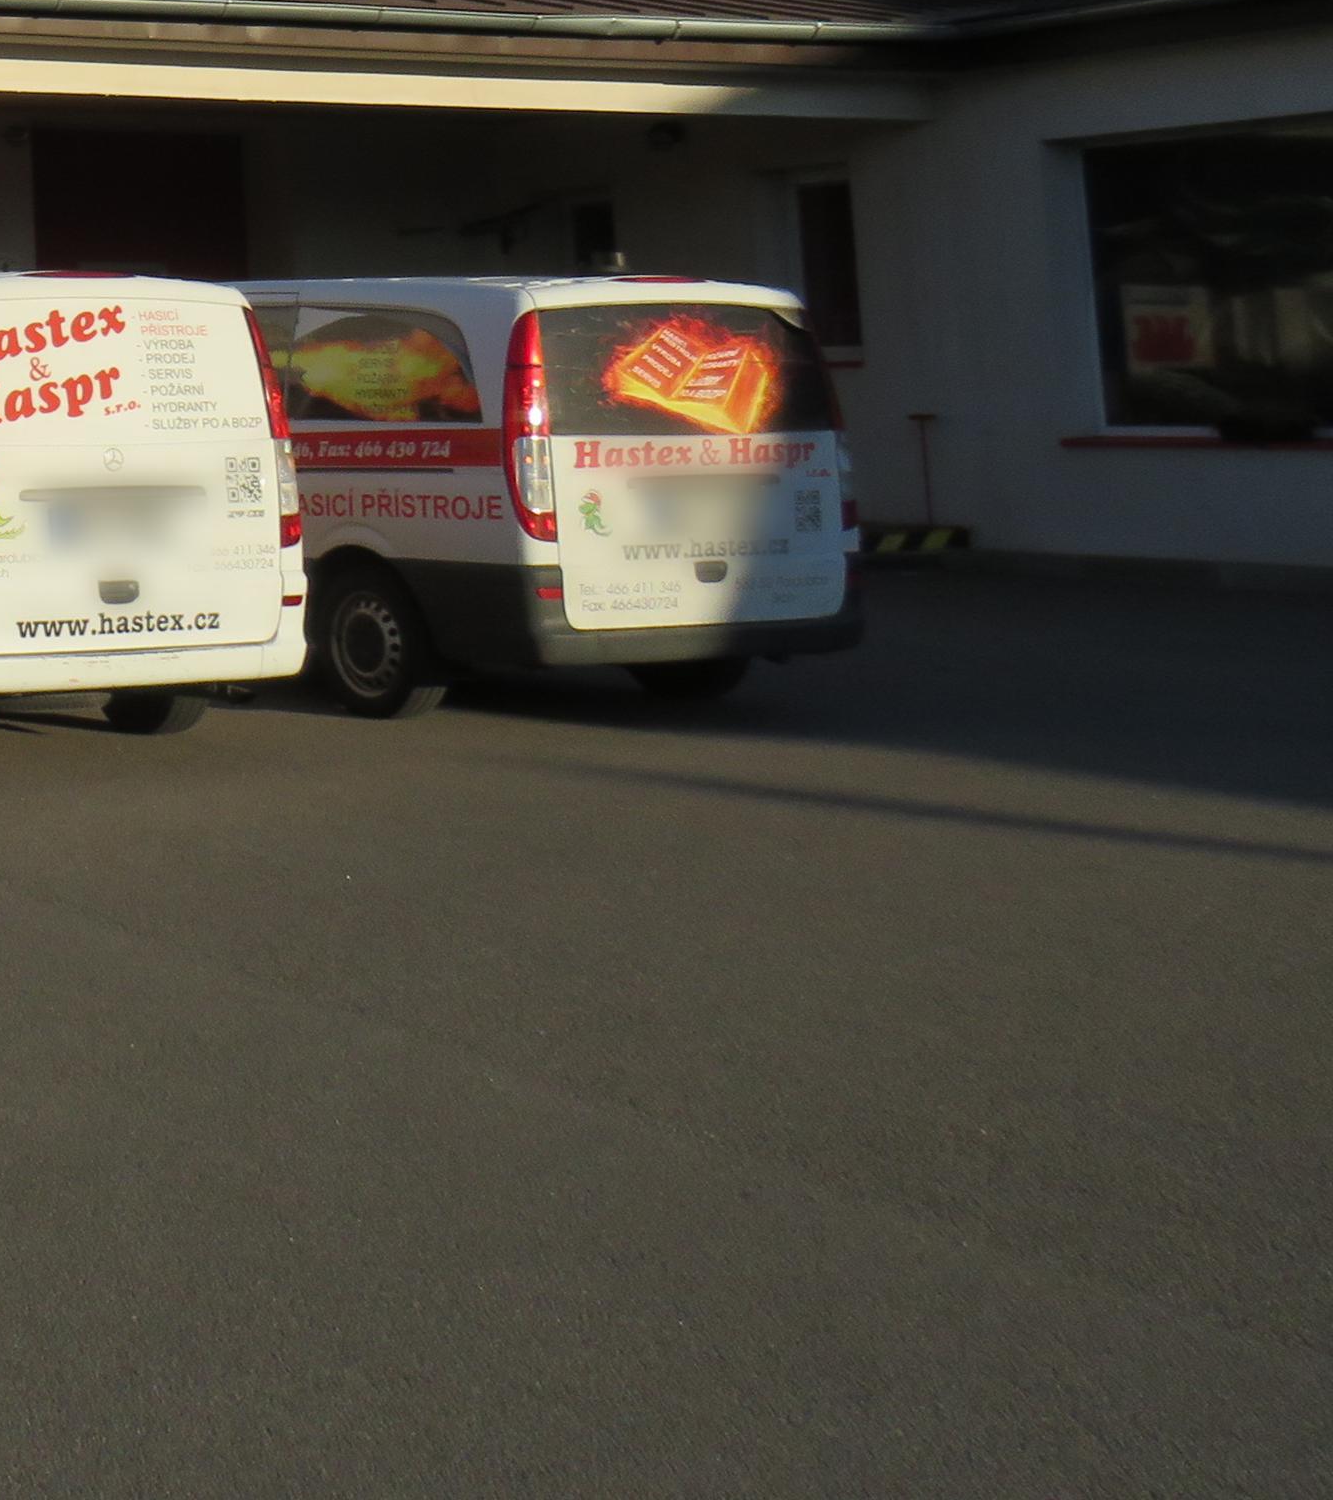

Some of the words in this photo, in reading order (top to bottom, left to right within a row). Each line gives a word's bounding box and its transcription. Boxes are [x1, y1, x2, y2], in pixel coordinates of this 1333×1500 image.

[146, 353, 195, 364] PRODEJ
[29, 357, 51, 381] &
[148, 368, 193, 380] SERVIS
[104, 400, 141, 416] s.r.o.
[152, 400, 217, 412] HYDRANTY
[202, 418, 220, 428] PO
[233, 417, 262, 428] BOZP
[293, 442, 314, 460] 46,
[354, 442, 382, 457] 466
[421, 441, 450, 458] 724
[574, 440, 692, 469] Hastex
[699, 439, 722, 465] &
[728, 438, 816, 468] Haspr
[298, 489, 354, 517] ASICÍ
[361, 487, 502, 519] PŘÍSTROJE
[623, 539, 789, 560] www.hastex.cz
[606, 583, 629, 594] 466
[633, 581, 653, 593] 411
[659, 580, 682, 593] 346
[16, 610, 221, 638] www.hastex.cz
